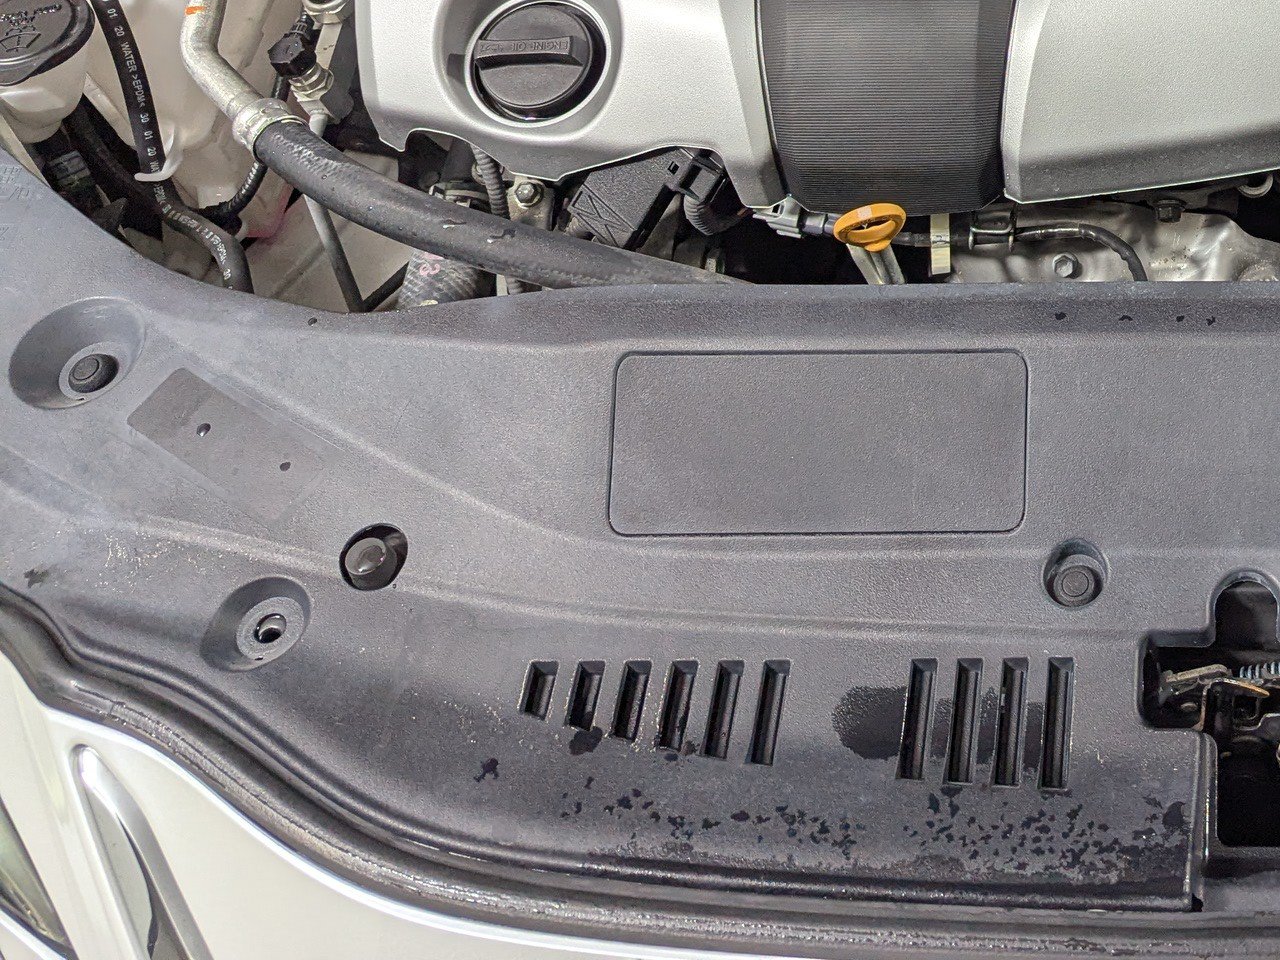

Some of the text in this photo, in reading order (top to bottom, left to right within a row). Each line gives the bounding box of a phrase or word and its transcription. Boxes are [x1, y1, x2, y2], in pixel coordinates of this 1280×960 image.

[107, 8, 118, 18] 01
[114, 25, 125, 37] 20
[511, 41, 527, 51] OIL
[530, 41, 569, 51] ENGINE
[121, 41, 138, 73] WATER
[131, 74, 146, 108] >EPDM<
[140, 112, 150, 123] 30
[144, 130, 154, 140] 01
[147, 146, 157, 157] 20
